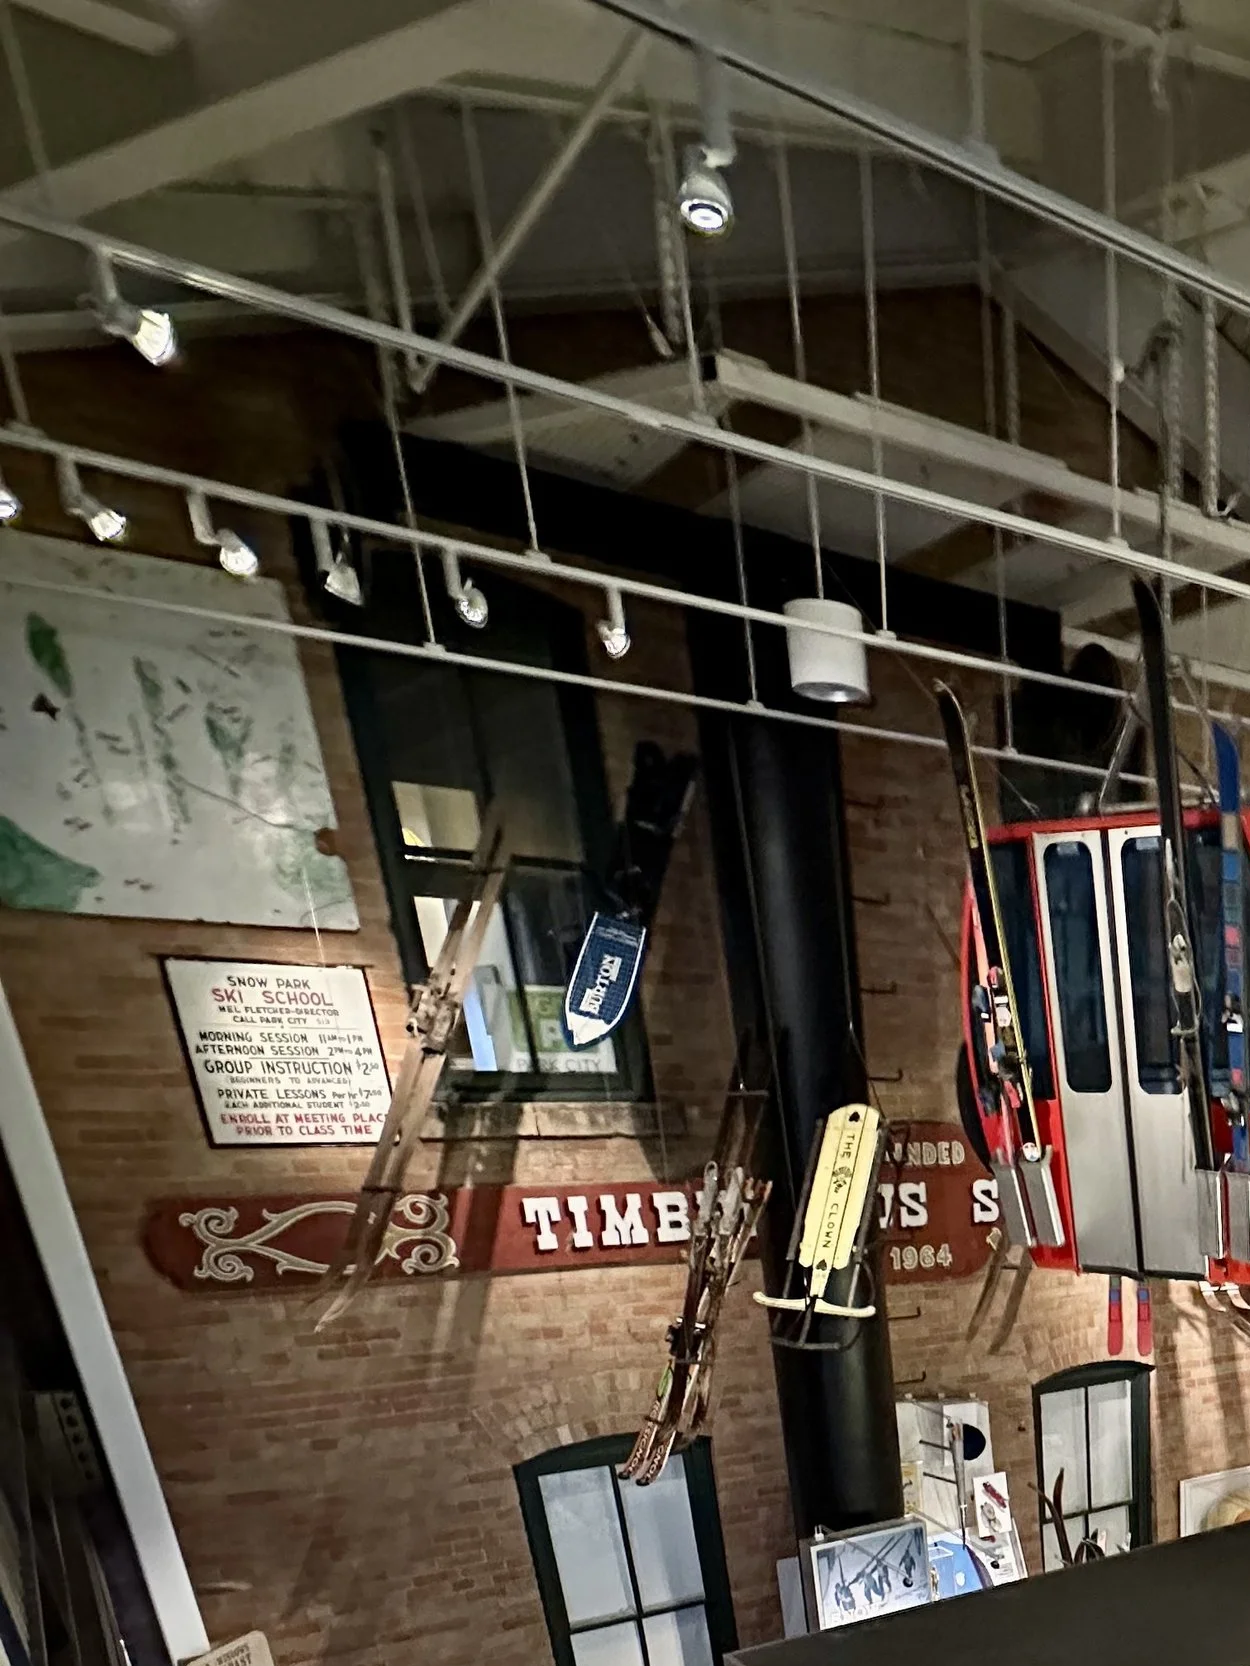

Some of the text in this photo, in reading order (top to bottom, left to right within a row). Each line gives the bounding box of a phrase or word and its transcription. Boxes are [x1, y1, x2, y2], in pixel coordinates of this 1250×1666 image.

[227, 975, 311, 990] SNOW PARK
[212, 989, 334, 1006] SKI SCHOOL
[233, 1015, 257, 1024] CALL
[288, 1017, 307, 1025] CITY
[199, 1031, 253, 1042] MORNING
[259, 1032, 309, 1043] SESSION
[195, 1045, 265, 1055] AFTERNOON
[271, 1046, 319, 1056] SESSION
[204, 1059, 253, 1075] GROUP
[261, 1061, 353, 1076] INSTRUCTION
[517, 1058, 559, 1072] PRK
[217, 1089, 269, 1099] PRIVATE
[277, 1089, 327, 1100] LESSONS
[306, 1101, 344, 1109] STUDENT
[220, 1112, 388, 1124] ENROLL AT MEETING PLAC
[236, 1125, 373, 1136] PRIOR TO CLASS TIME
[840, 1133, 856, 1159] THE
[822, 1202, 840, 1249] CLOWN
[889, 1243, 953, 1271] 1964
